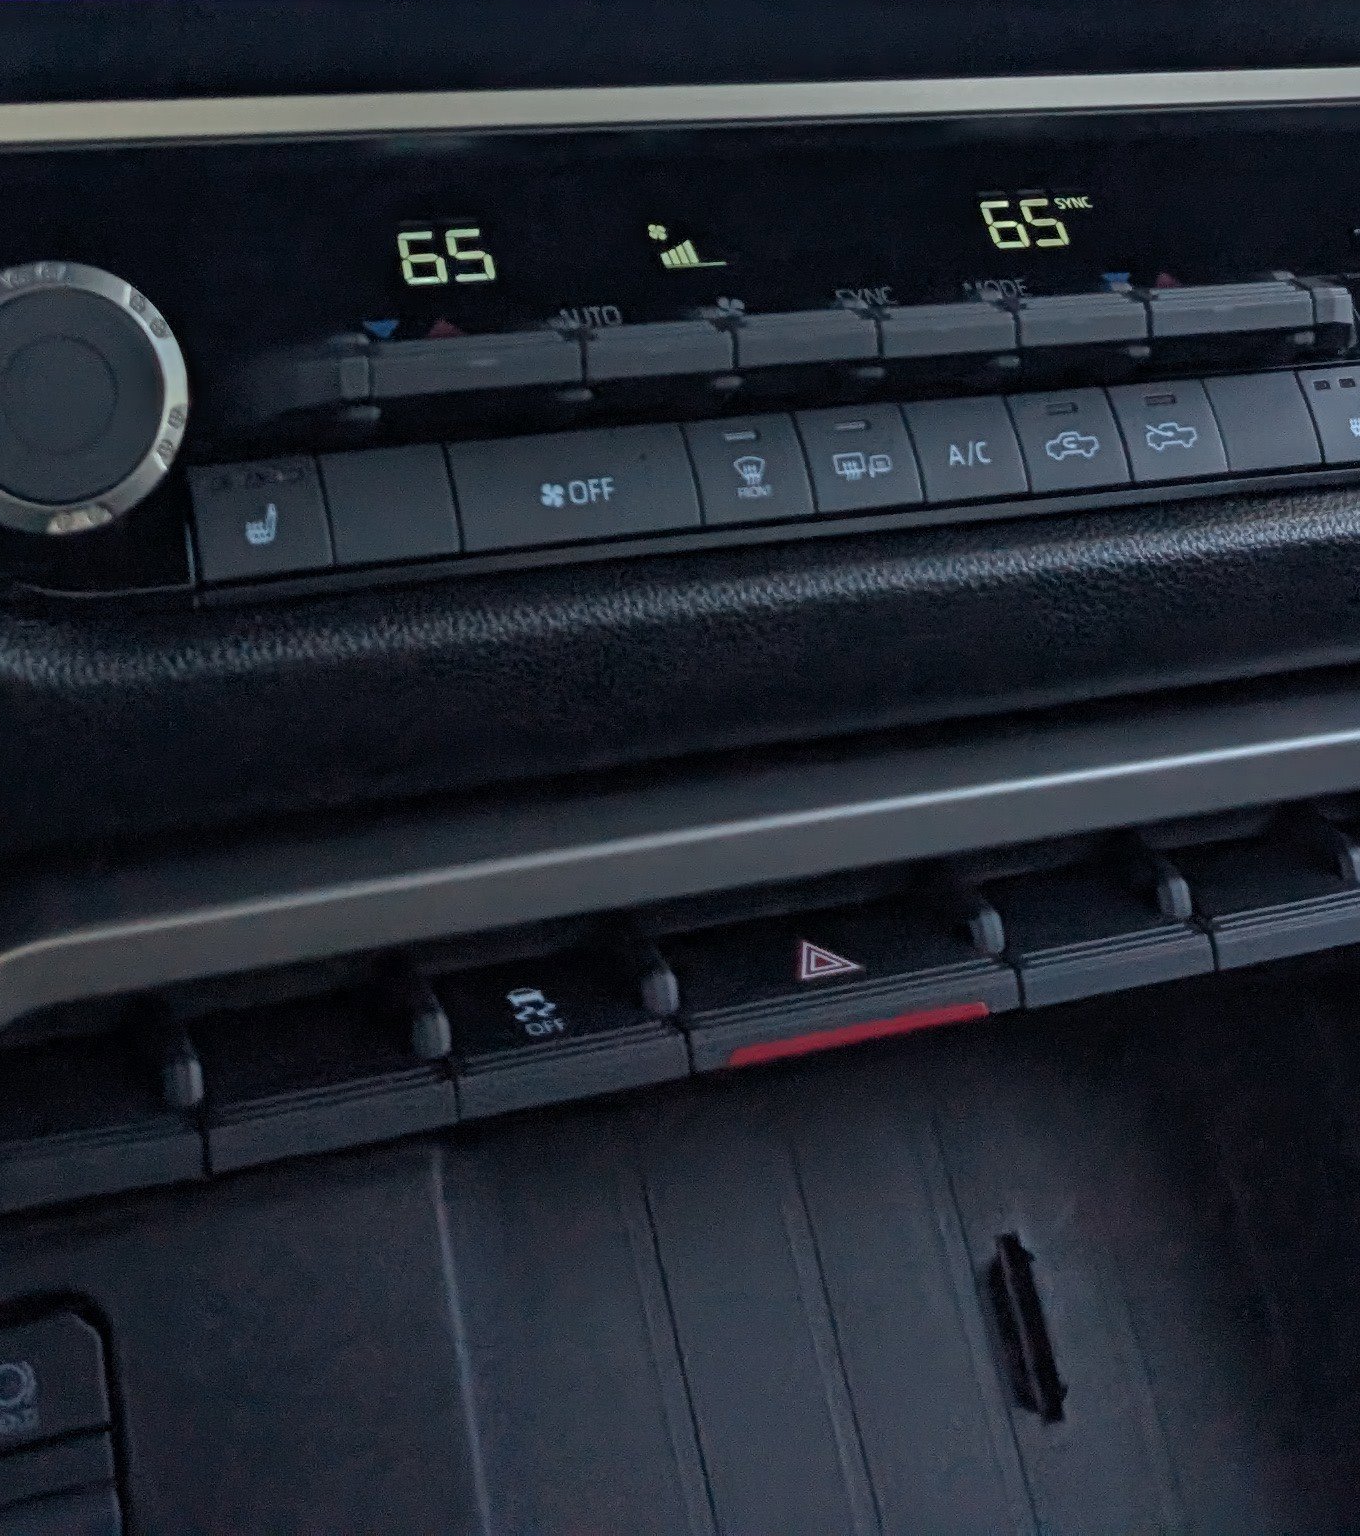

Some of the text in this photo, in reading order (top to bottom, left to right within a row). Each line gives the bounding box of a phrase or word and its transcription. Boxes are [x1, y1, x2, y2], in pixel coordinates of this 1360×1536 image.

[980, 196, 1093, 249] 65 SYNC
[397, 228, 496, 285] 65
[949, 440, 993, 466] A/C
[568, 476, 614, 505] OFF
[525, 1017, 564, 1036] OFF
